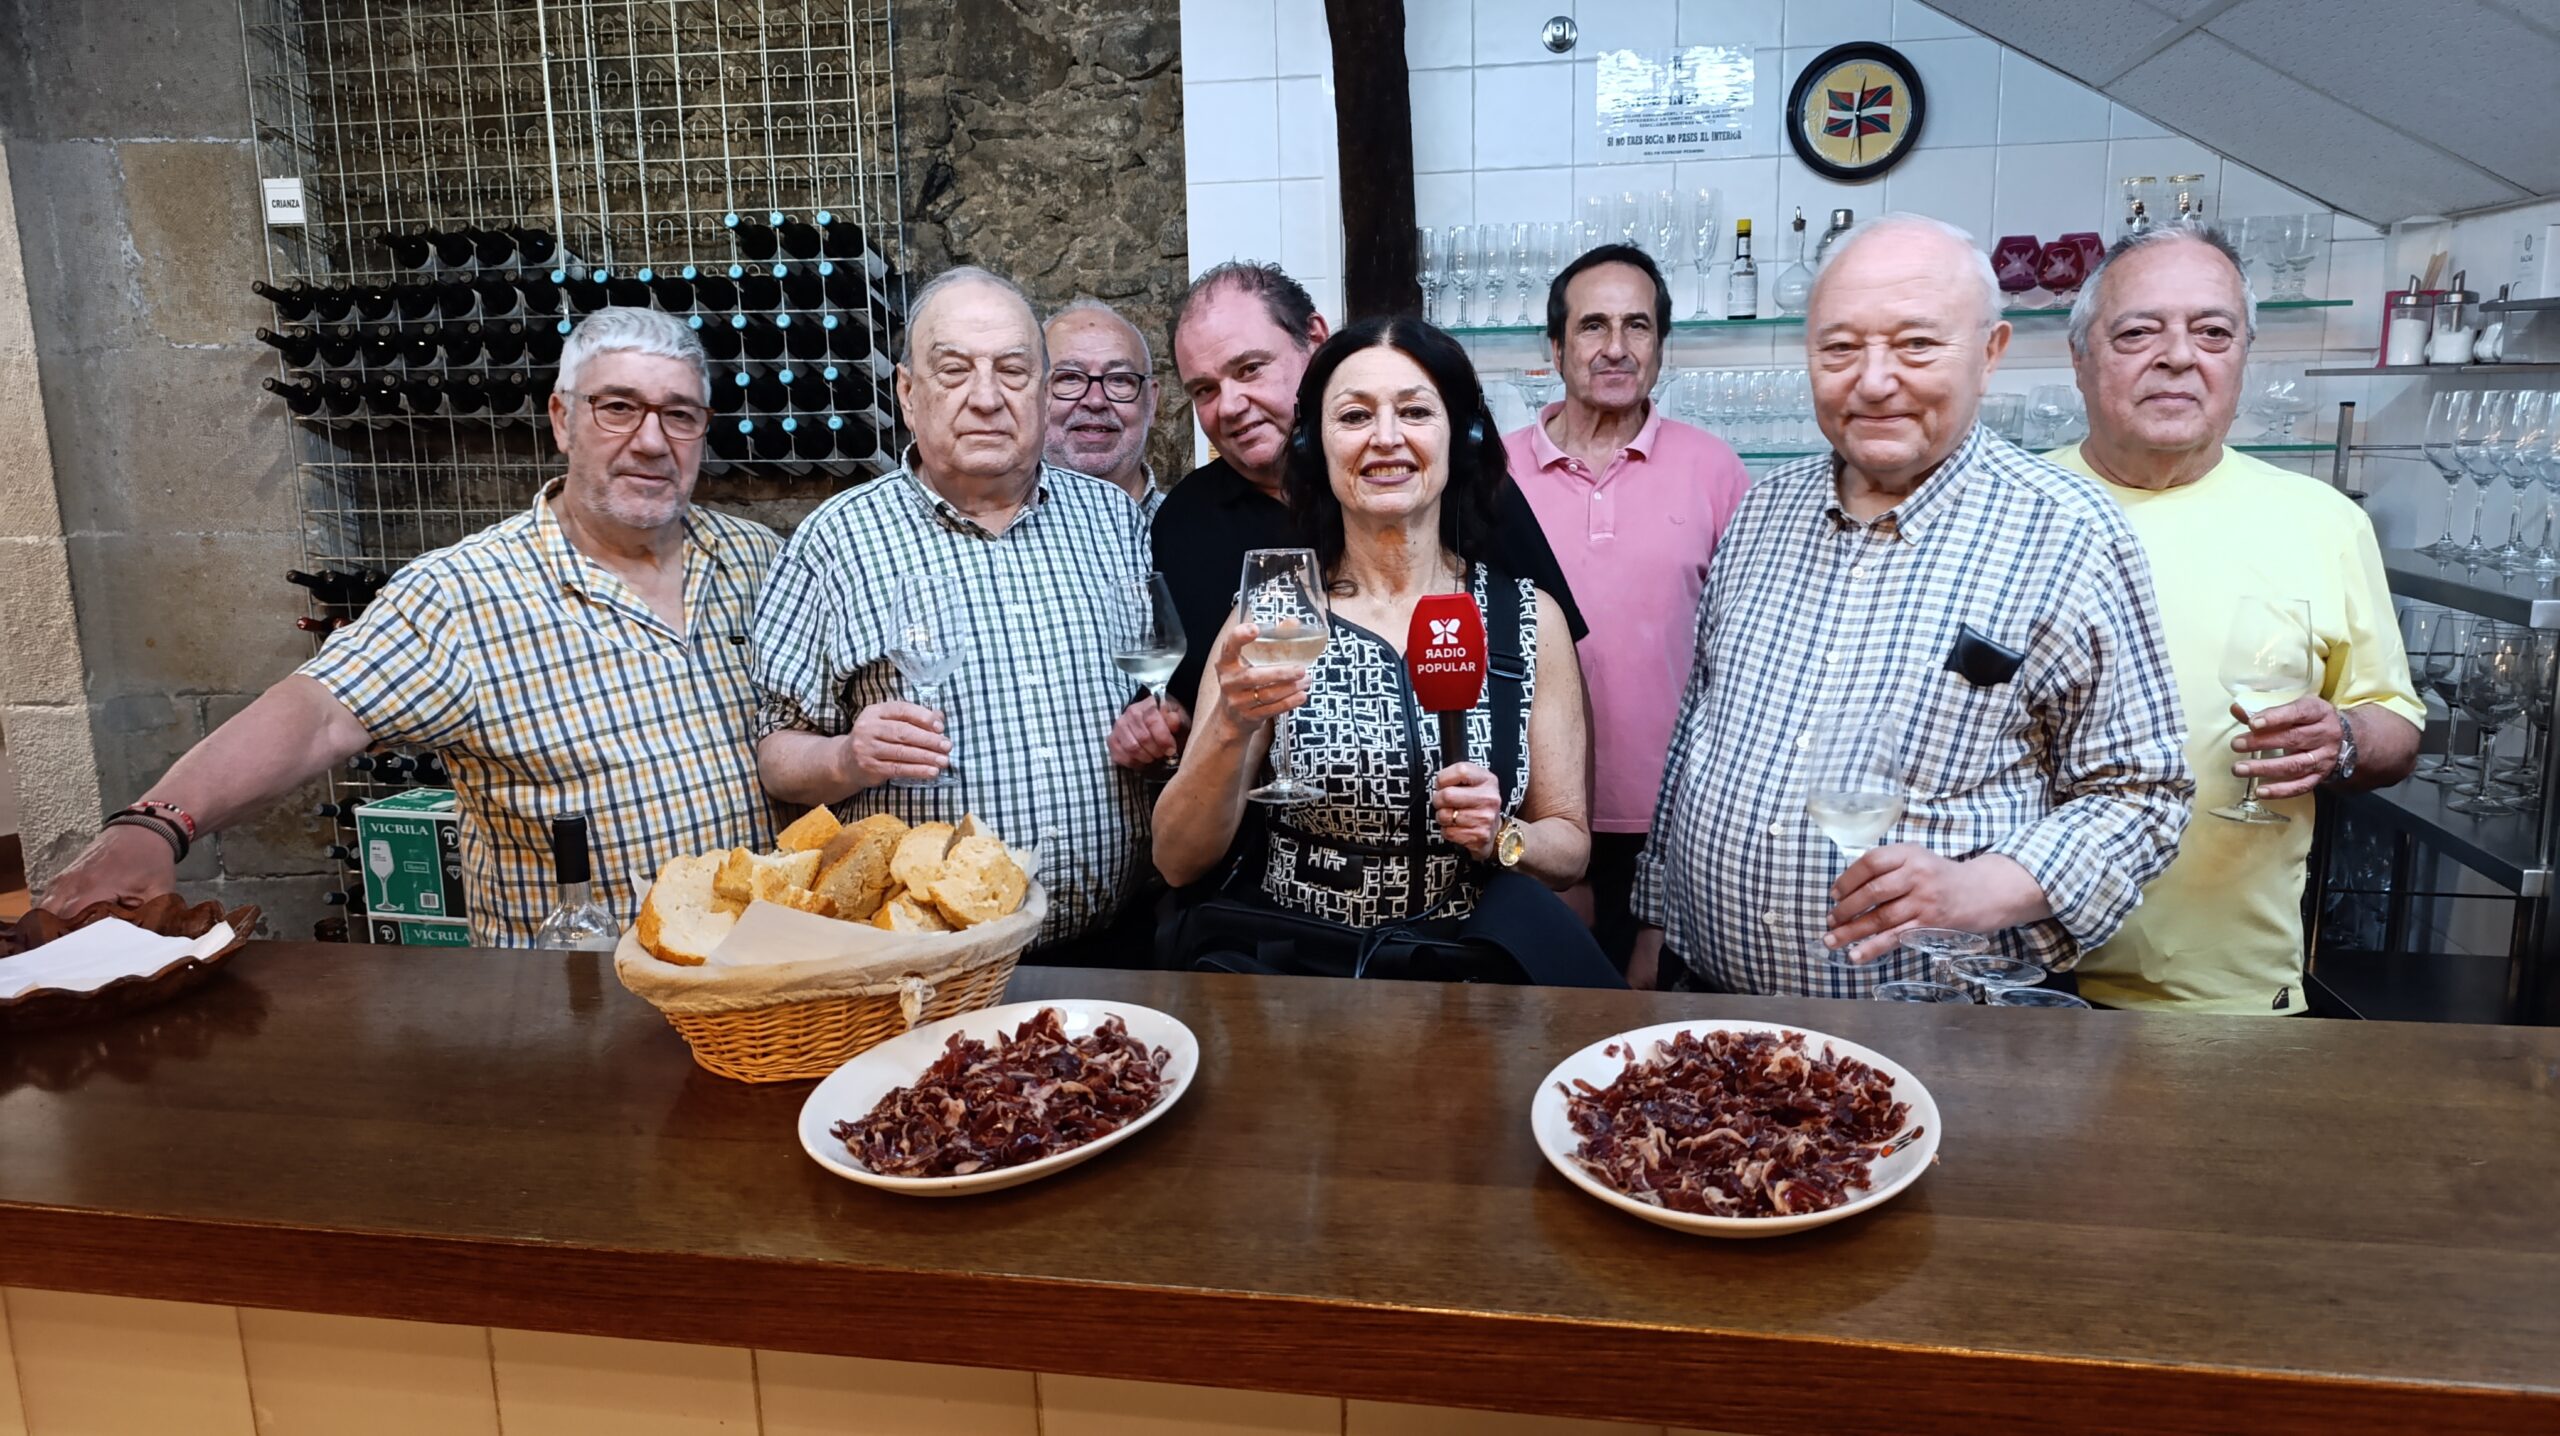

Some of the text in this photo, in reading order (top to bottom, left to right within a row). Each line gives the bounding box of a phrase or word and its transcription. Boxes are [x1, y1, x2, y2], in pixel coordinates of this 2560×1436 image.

[1616, 136, 1625, 146] NO
[1627, 135, 1643, 146] ERES
[1666, 133, 1676, 144] NO
[1678, 131, 1698, 143] PASES
[271, 199, 300, 208] CRIANZA
[1417, 661, 1476, 675] POPULAR
[370, 823, 429, 836] VICRILA
[413, 928, 471, 943] VICRILA
